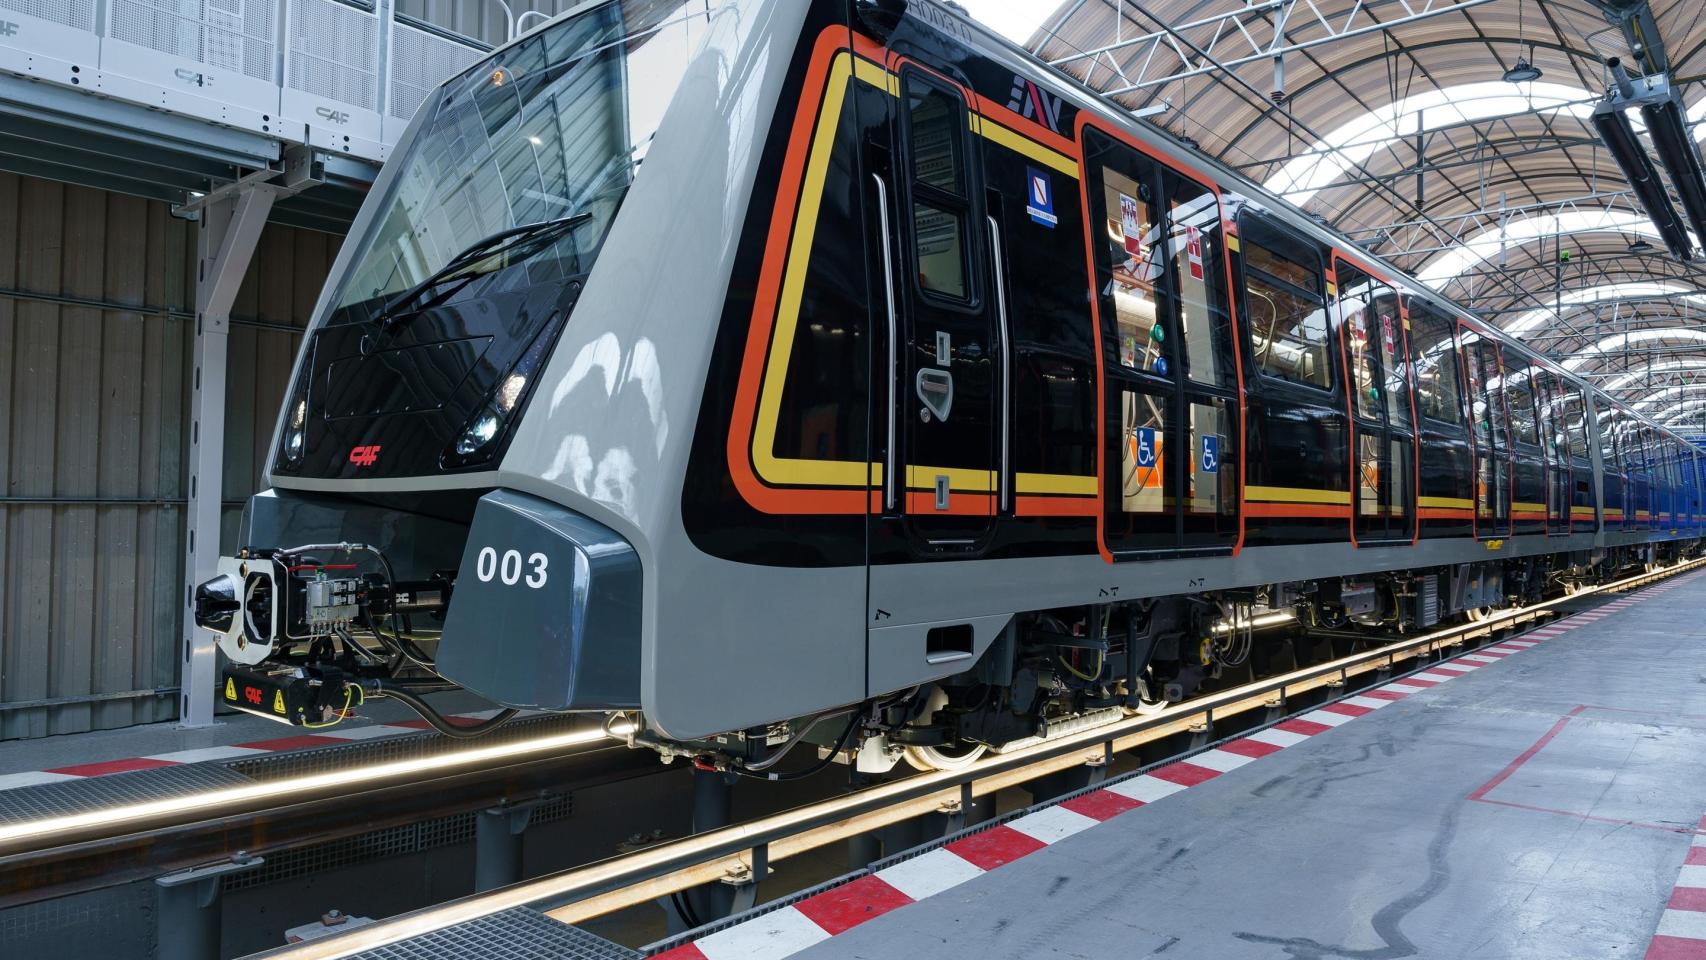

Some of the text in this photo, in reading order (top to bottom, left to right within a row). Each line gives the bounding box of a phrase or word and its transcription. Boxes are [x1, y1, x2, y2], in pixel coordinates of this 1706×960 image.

[316, 106, 350, 125] CAF
[350, 445, 382, 466] CAF
[477, 546, 549, 589] 003
[245, 686, 262, 704] CAF
